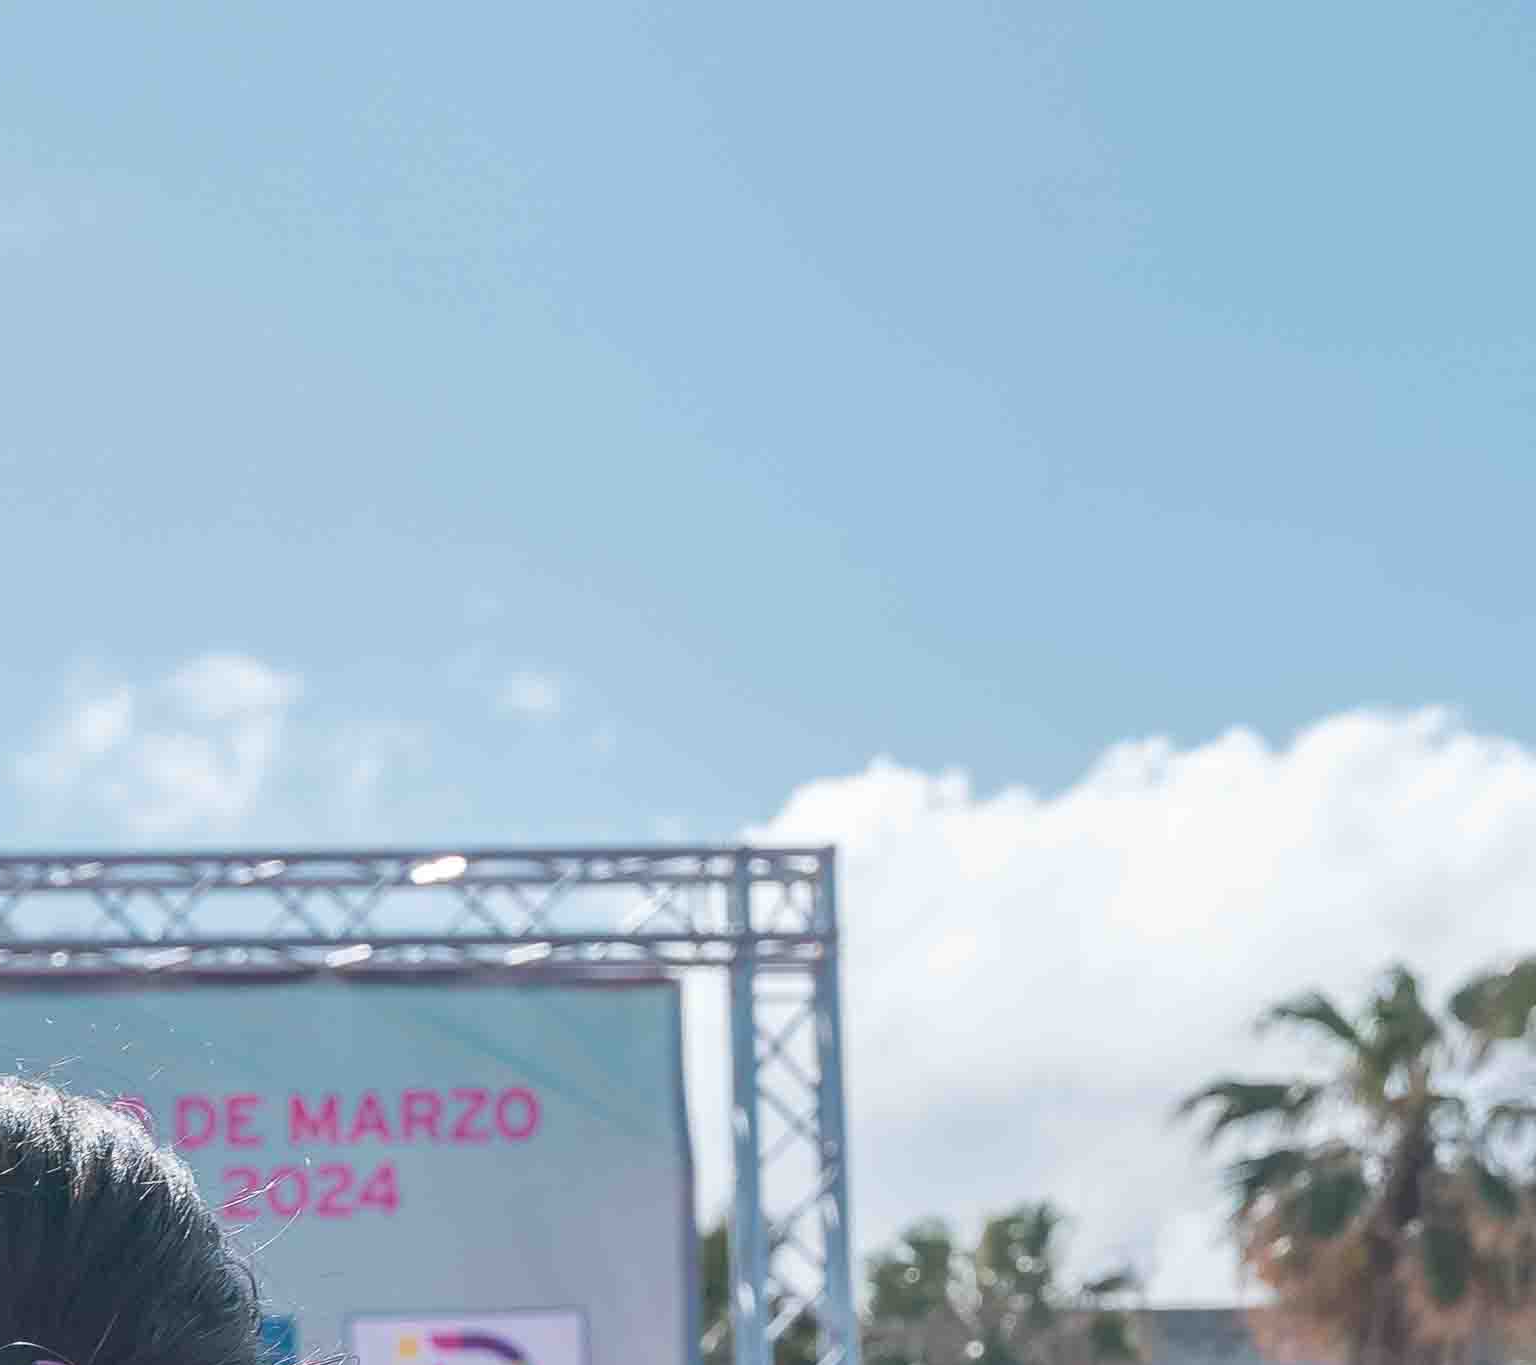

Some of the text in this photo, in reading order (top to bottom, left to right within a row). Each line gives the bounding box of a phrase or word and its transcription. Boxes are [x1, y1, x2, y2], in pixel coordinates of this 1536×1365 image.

[174, 1093, 264, 1150] DE
[288, 1086, 543, 1146] MARZO
[221, 1160, 402, 1219] 2024
